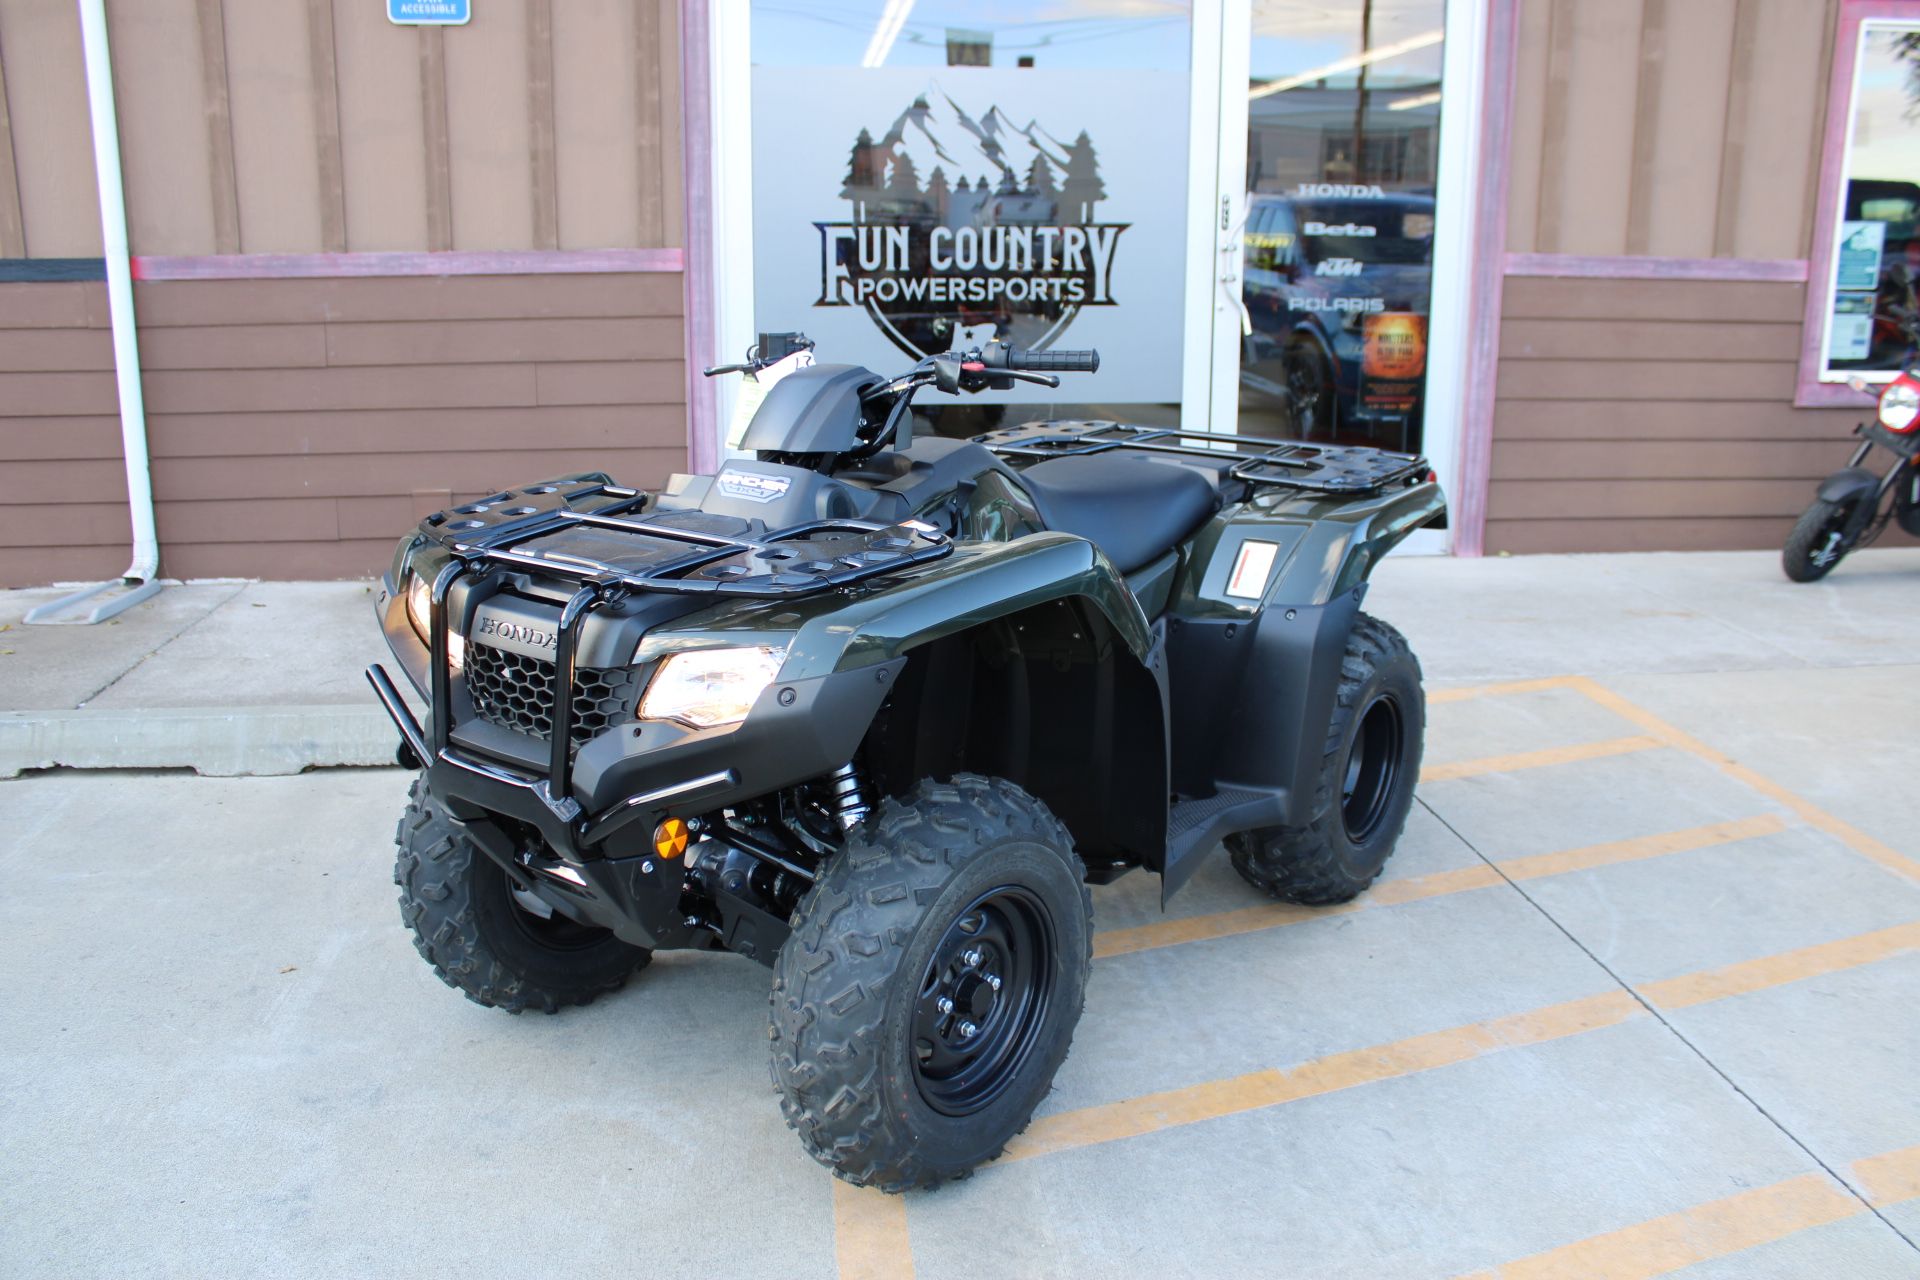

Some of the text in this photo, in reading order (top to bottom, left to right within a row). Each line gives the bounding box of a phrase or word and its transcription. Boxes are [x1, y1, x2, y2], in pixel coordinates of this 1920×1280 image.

[401, 3, 457, 15] ACCESSIBLE
[1298, 184, 1386, 199] HONDA
[1304, 222, 1377, 237] Beta
[824, 225, 1119, 303] FUN COUNTRY
[1315, 258, 1364, 276] KTM
[857, 277, 1085, 301] POWERSPORTS
[1288, 297, 1385, 312] POLARIS
[479, 617, 557, 650] HONDA
